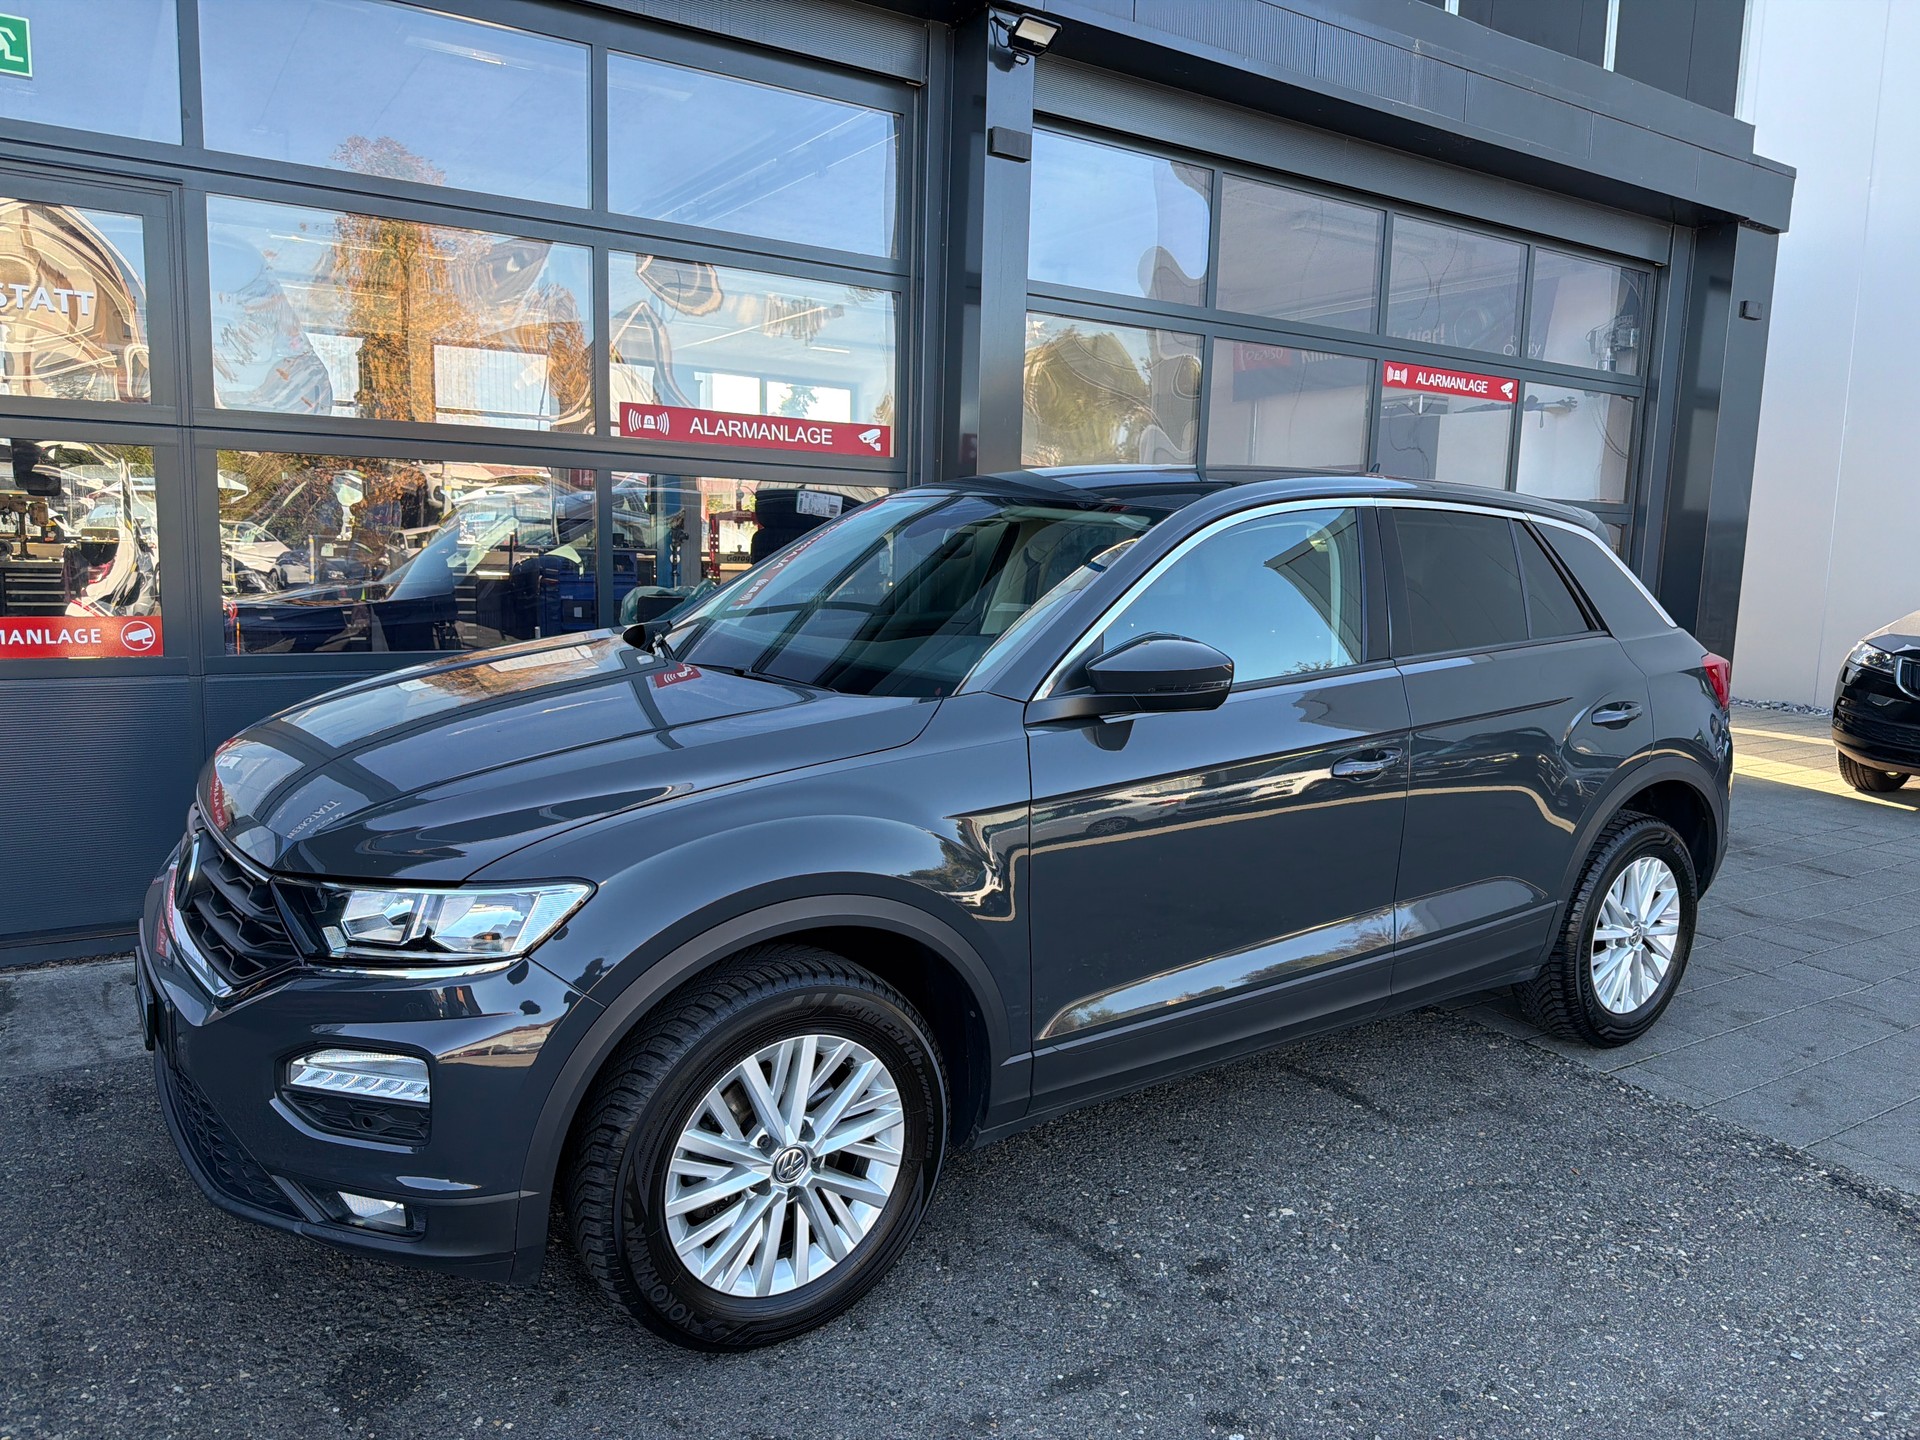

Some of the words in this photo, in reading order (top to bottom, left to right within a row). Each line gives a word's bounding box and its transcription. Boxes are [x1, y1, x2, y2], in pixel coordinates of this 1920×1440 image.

[1416, 371, 1488, 393] ALARMANLAGE
[690, 416, 833, 445] ALARMANLAGE
[0, 629, 101, 644] ANLAGE
[624, 1221, 696, 1329] YOKOHAMA
